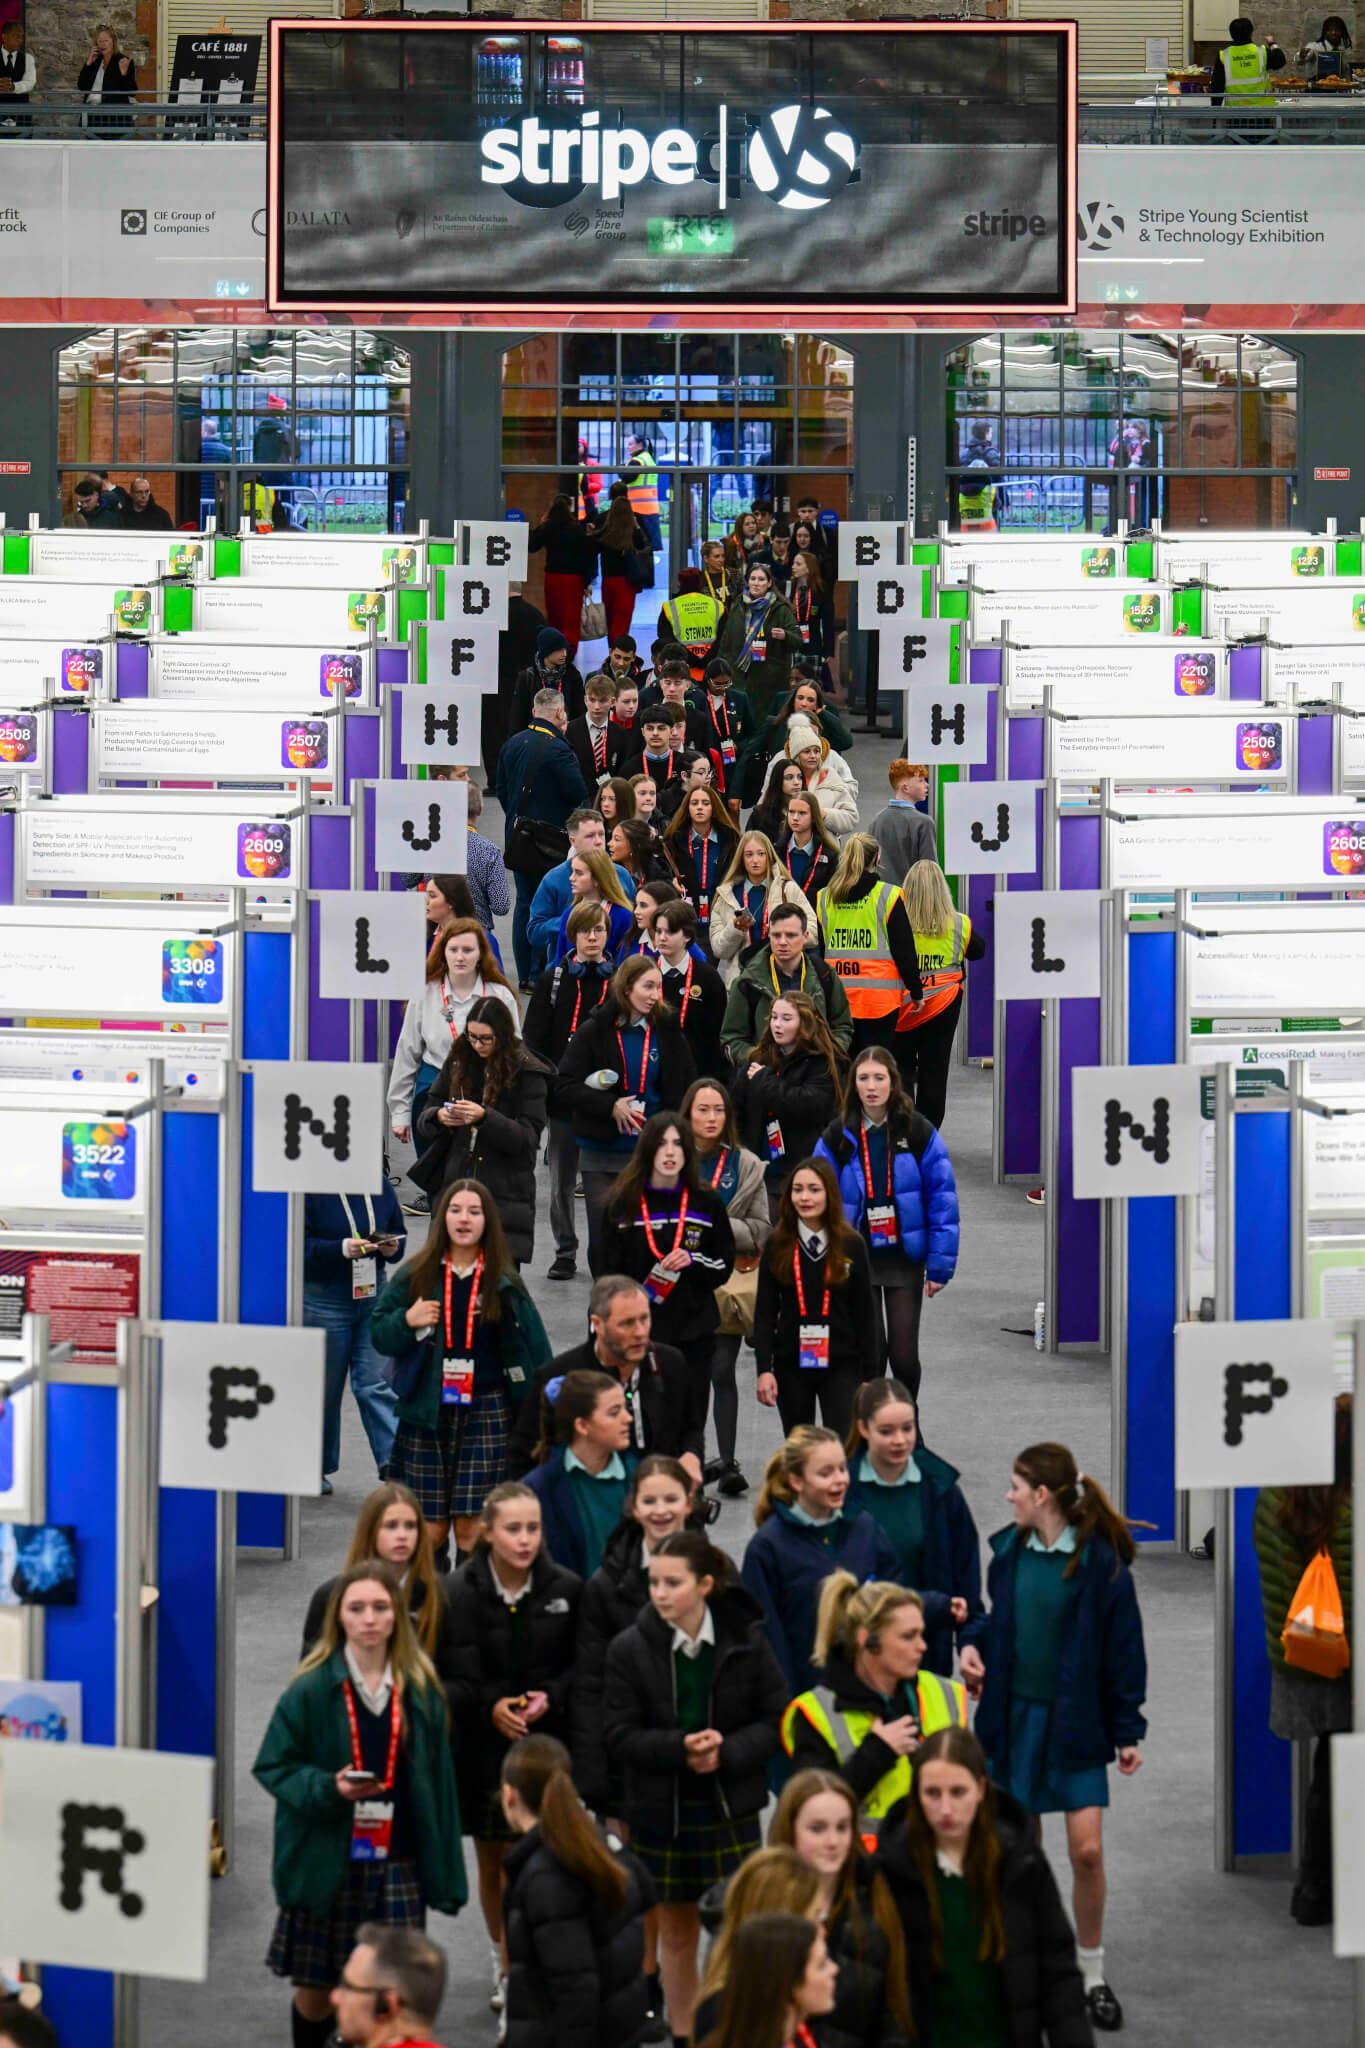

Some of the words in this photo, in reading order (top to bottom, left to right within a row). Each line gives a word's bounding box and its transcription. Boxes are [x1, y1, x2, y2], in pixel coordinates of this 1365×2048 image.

[191, 40, 221, 52] CAFÉ
[223, 43, 248, 52] 1881
[480, 110, 698, 200] stripe
[171, 211, 196, 223] Group
[201, 210, 216, 220] of
[287, 211, 351, 225] DALATA
[595, 209, 624, 219] Speed
[1138, 208, 1185, 225] Stripe
[1188, 209, 1237, 225] Young
[1241, 209, 1309, 223] Scientist
[153, 223, 211, 235] Companies
[595, 221, 621, 230] Fibre
[964, 208, 1046, 242] stripe
[595, 231, 625, 241] Group
[1138, 229, 1151, 242] &
[1155, 229, 1245, 245] Technology
[1249, 229, 1325, 243] Exhibition
[487, 536, 511, 566] B
[856, 536, 880, 566] B
[1087, 557, 1109, 567] 1544
[1297, 557, 1319, 566] 1223
[463, 581, 490, 614] D
[877, 580, 904, 614] D
[121, 601, 144, 611] 1525
[354, 604, 379, 614] 1524
[1130, 605, 1154, 615] 1523
[685, 626, 712, 640] STEWARD
[452, 638, 475, 676] F
[903, 635, 927, 672] F
[69, 661, 95, 672] 2212
[329, 667, 353, 677] 2211
[1181, 666, 1208, 676] 2210
[425, 703, 459, 745] H
[932, 703, 965, 745] H
[0, 728, 31, 740] 2508
[288, 734, 321, 747] 2507
[104, 737, 135, 746] Producing
[158, 738, 170, 747] Egg
[1243, 736, 1276, 748] 2506
[402, 803, 441, 851] J
[971, 803, 1010, 851] J
[32, 832, 54, 842] Sunny
[1330, 836, 1365, 850] 2608
[245, 839, 284, 853] 2609
[32, 850, 72, 859] Ingredients
[79, 851, 110, 859] Skincare
[125, 852, 152, 861] Makeup
[153, 853, 185, 861] Products
[356, 917, 390, 973] L
[830, 928, 872, 948] STEWARD
[1031, 917, 1065, 973] L
[170, 958, 215, 974] 3308
[835, 961, 860, 976] 060
[917, 953, 945, 972] URITY
[1319, 1050, 1346, 1061] Making
[284, 1093, 350, 1162] N
[1104, 1097, 1170, 1166] N
[72, 1144, 125, 1164] 3522
[208, 1366, 275, 1449] P
[1224, 1362, 1289, 1447] P
[59, 1802, 145, 1918] R
